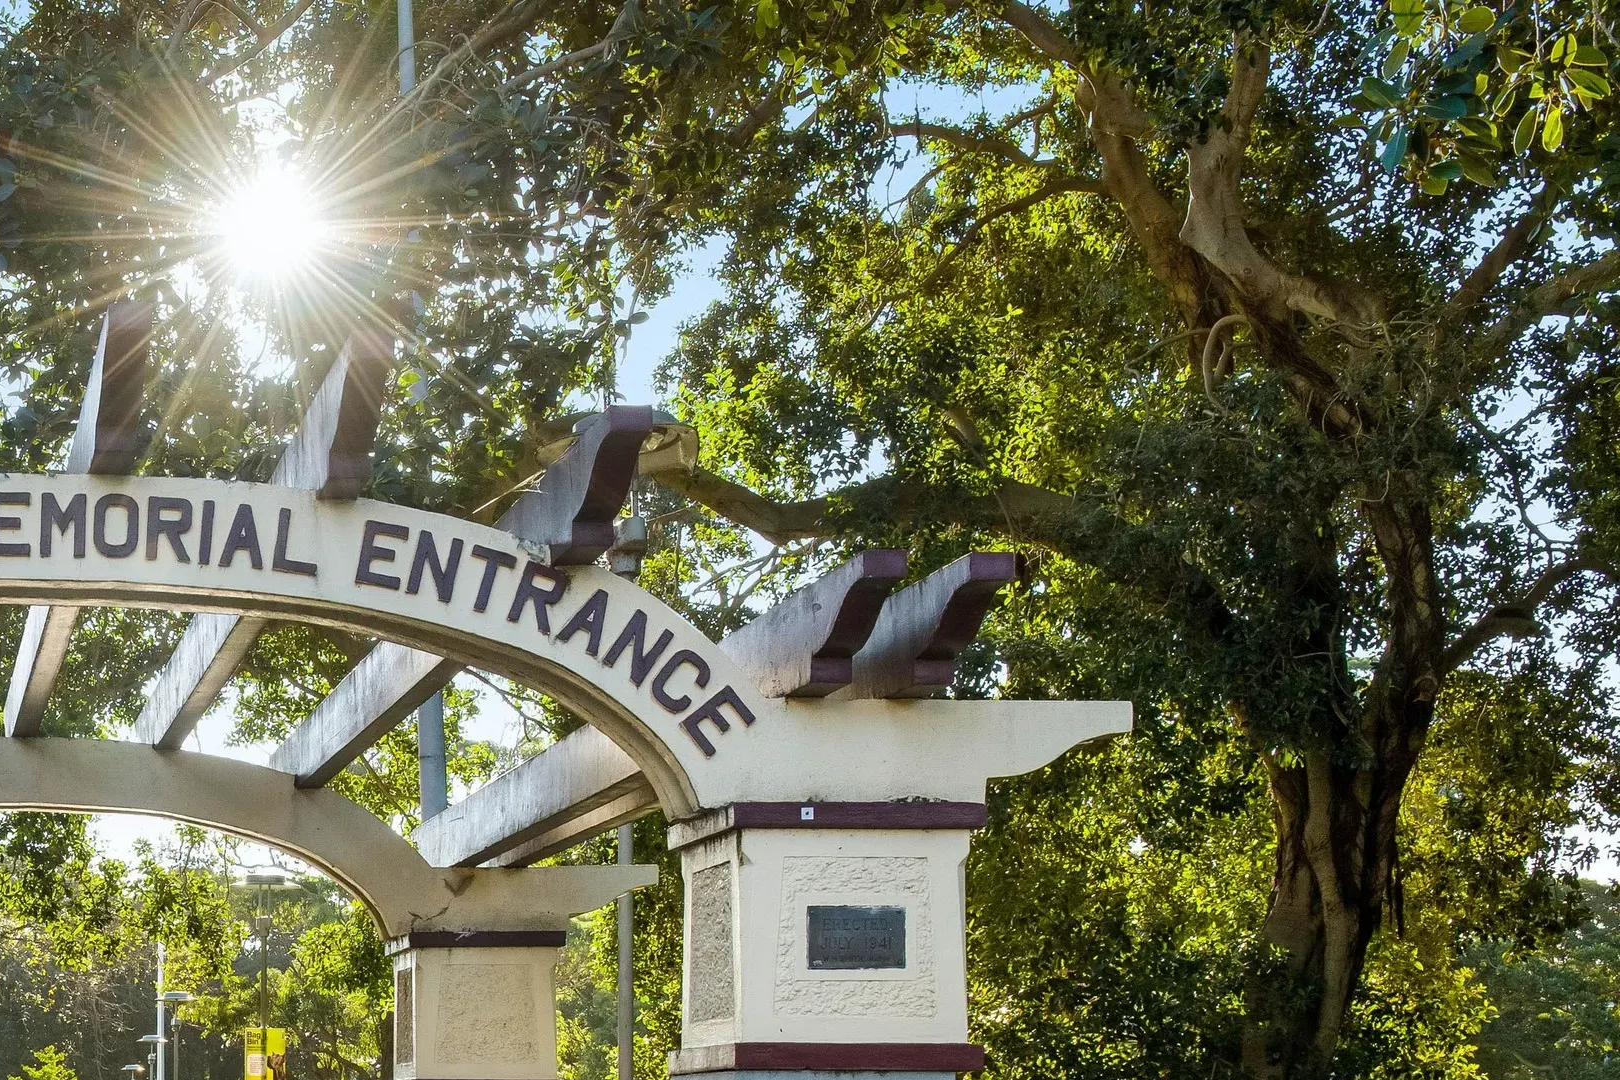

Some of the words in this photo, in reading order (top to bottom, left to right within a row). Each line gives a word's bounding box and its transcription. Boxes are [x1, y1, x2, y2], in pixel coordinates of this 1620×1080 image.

[354, 519, 757, 758] ENTRANCE
[823, 917, 888, 931] ERECTED
[820, 936, 855, 950] JULY
[864, 936, 891, 950] 1941
[247, 1031, 261, 1040] Bag
